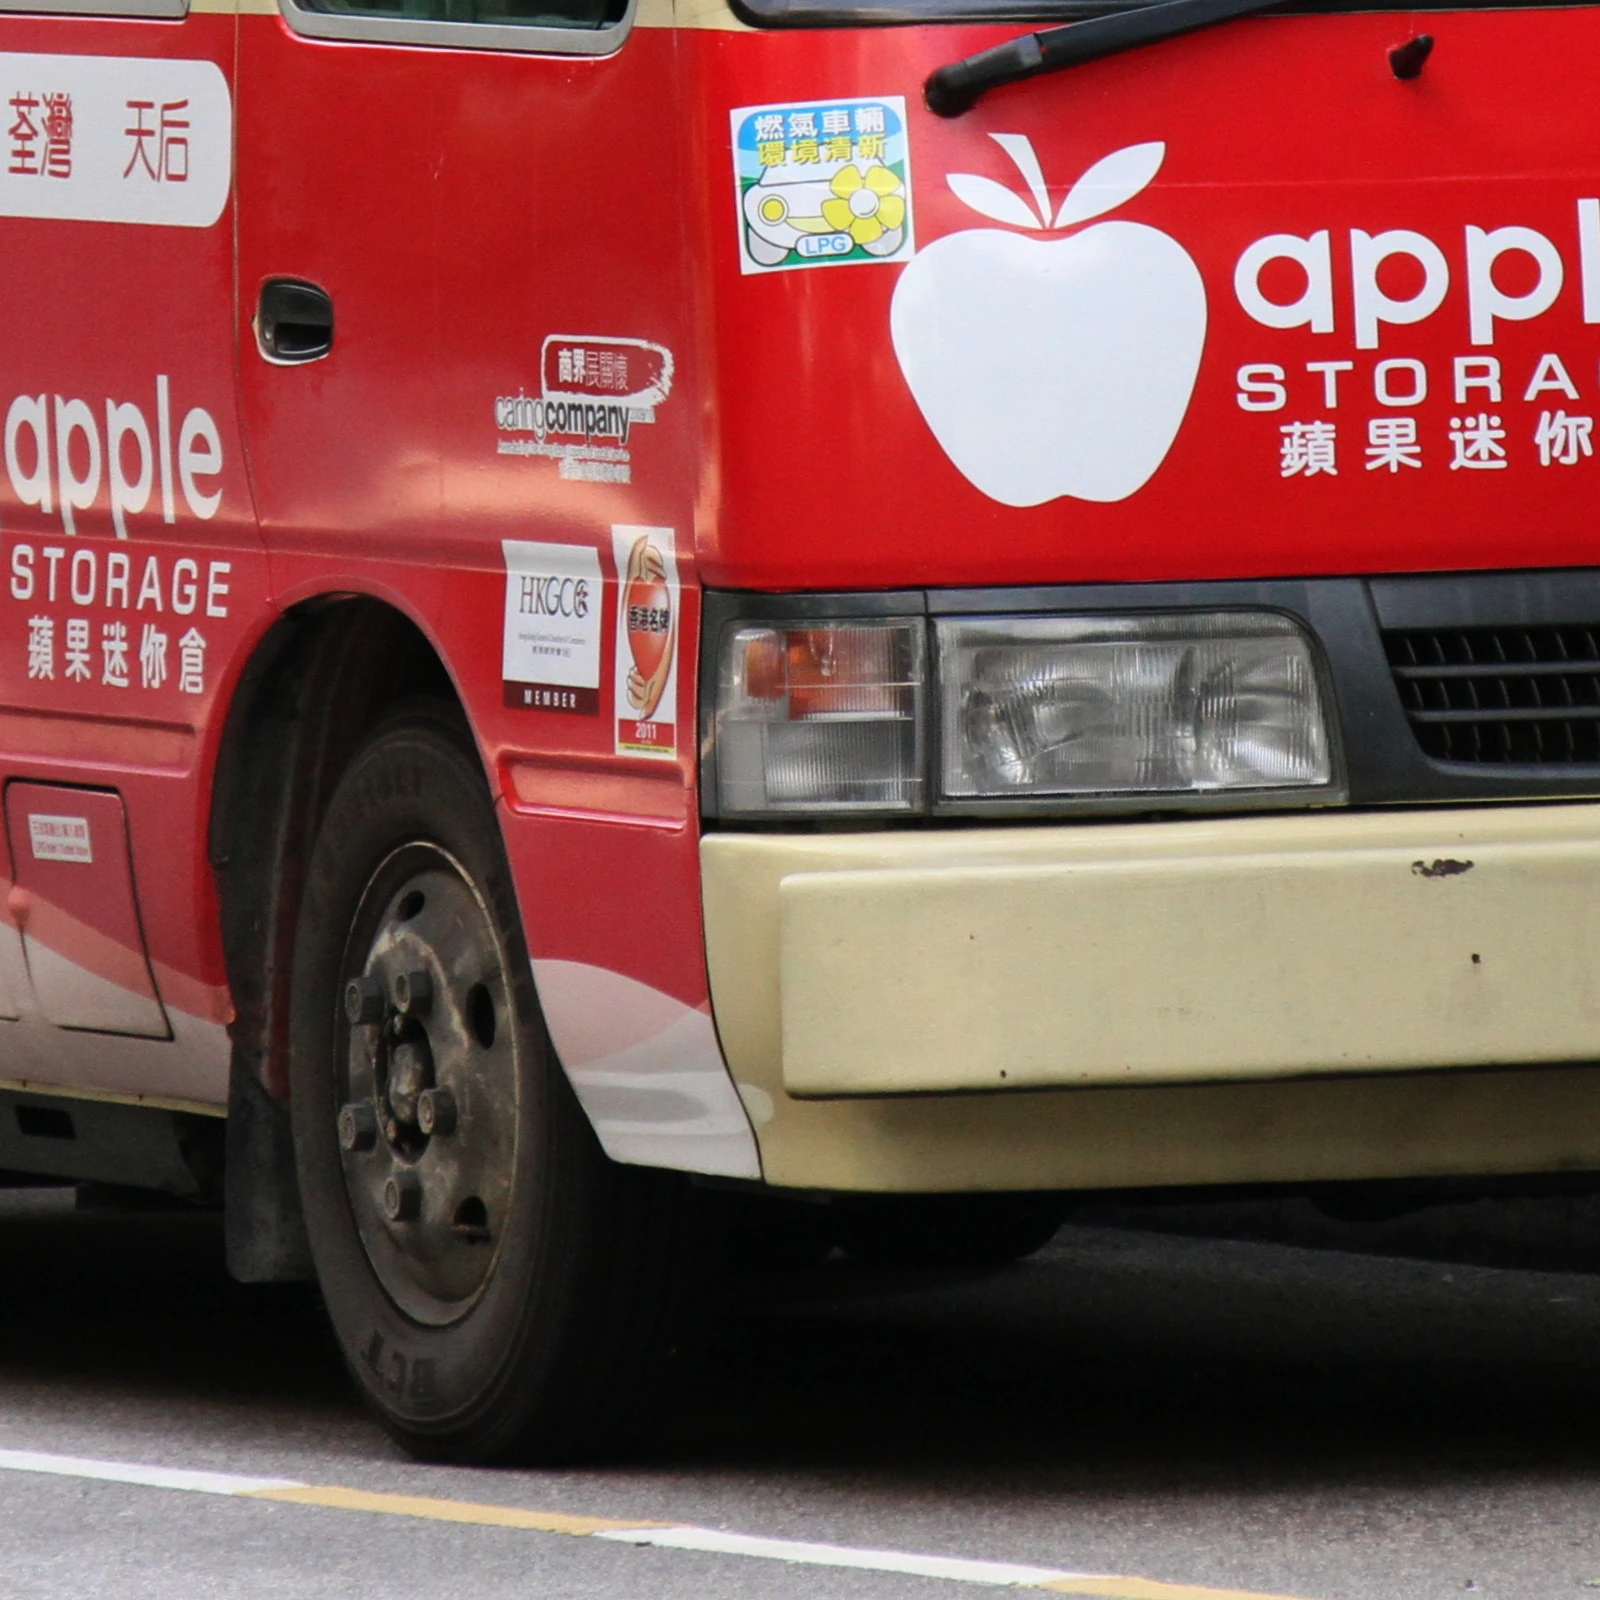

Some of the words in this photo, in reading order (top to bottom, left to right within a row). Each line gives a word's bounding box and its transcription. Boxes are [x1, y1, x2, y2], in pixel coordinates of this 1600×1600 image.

[7, 91, 74, 181] 荃灣
[122, 98, 190, 185] 天后
[754, 107, 886, 141] 燃氣車輛
[757, 133, 887, 167] 環境清新
[804, 236, 848, 255] LPG
[4, 374, 224, 541] apple
[10, 543, 233, 619] STORAGE
[629, 604, 670, 633] 香港名牌
[27, 615, 207, 694] 蘋果迷你倉
[524, 689, 576, 709] MEMBER
[635, 722, 657, 740] 2011
